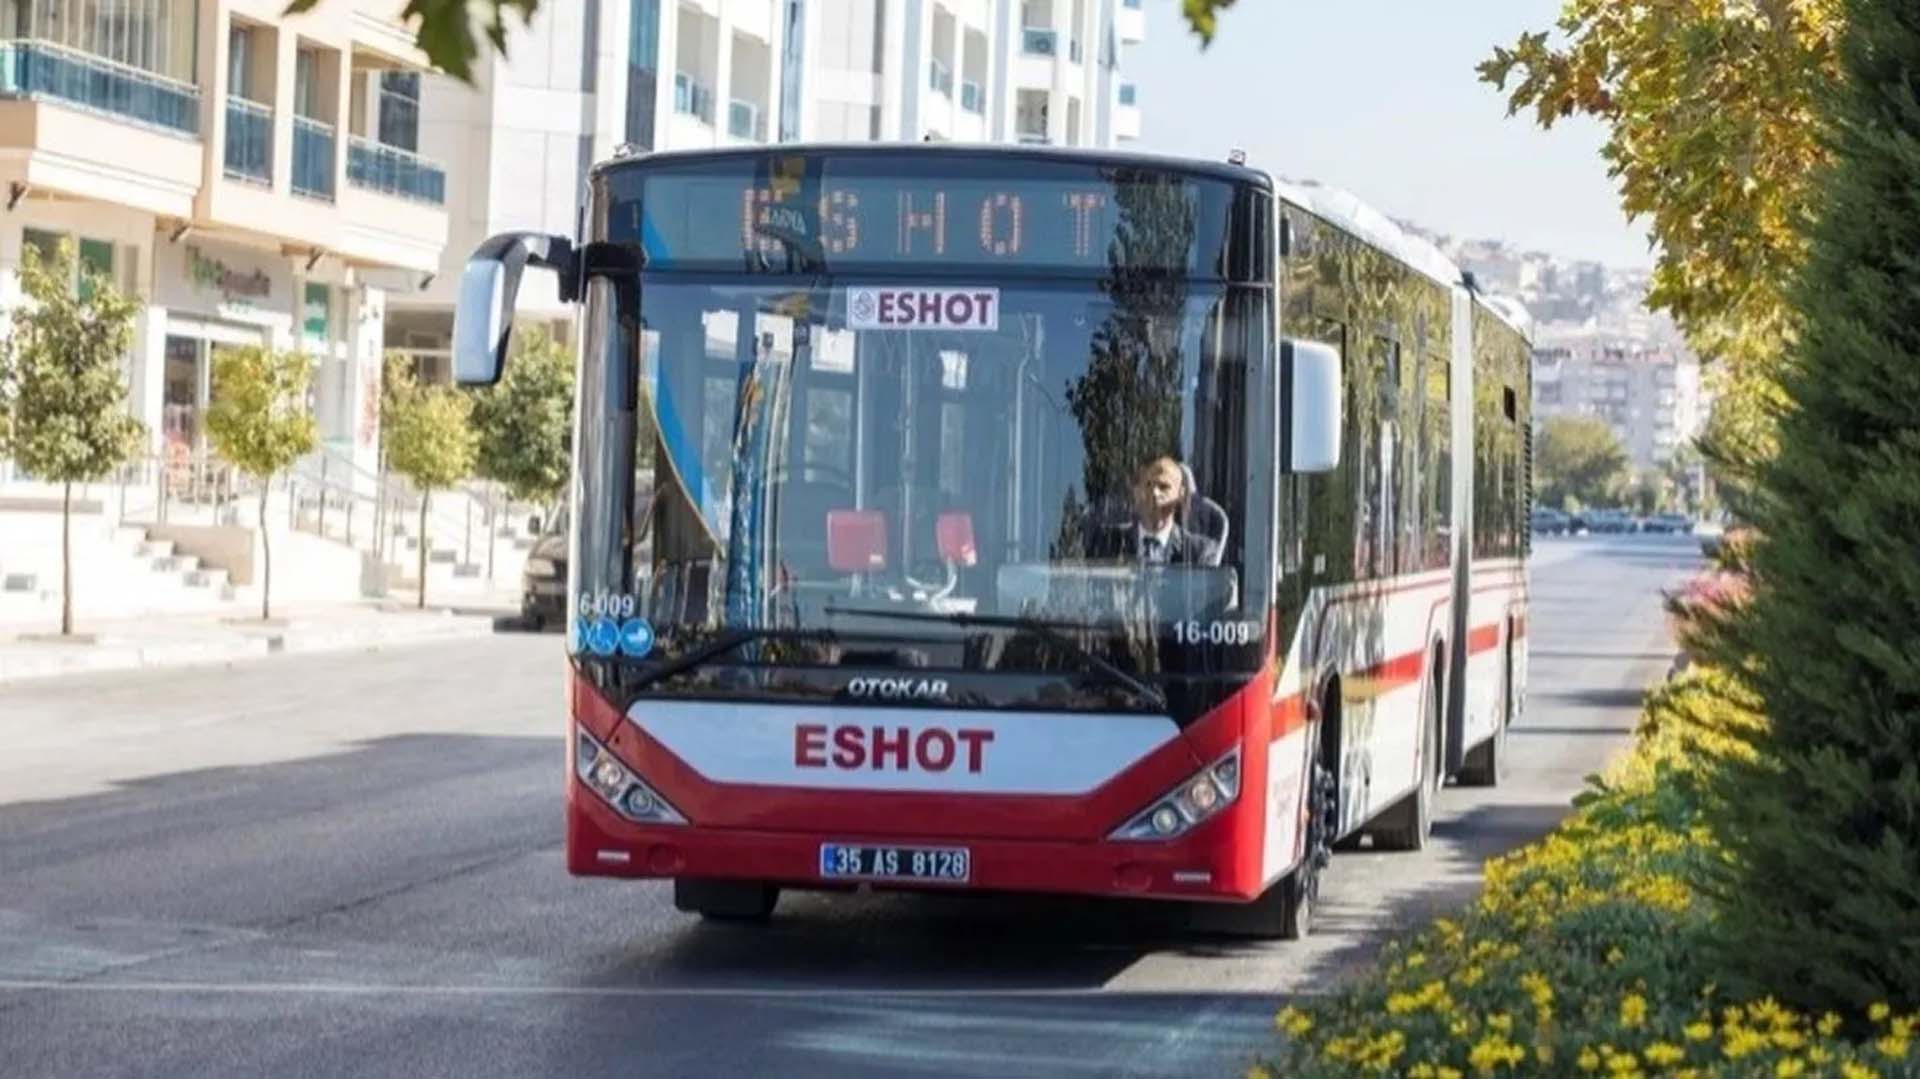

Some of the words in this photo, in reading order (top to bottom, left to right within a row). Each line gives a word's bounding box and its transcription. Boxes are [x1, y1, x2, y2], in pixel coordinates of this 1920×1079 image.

[743, 188, 1106, 256] ESHOT
[878, 292, 993, 325] ESHOT
[579, 592, 634, 618] 6-009
[1173, 620, 1249, 645] 16-009
[848, 677, 949, 698] OTOKAR
[794, 723, 995, 774] ESHOT
[837, 848, 862, 873] 35
[873, 849, 899, 875] AS
[912, 851, 965, 877] 8128
